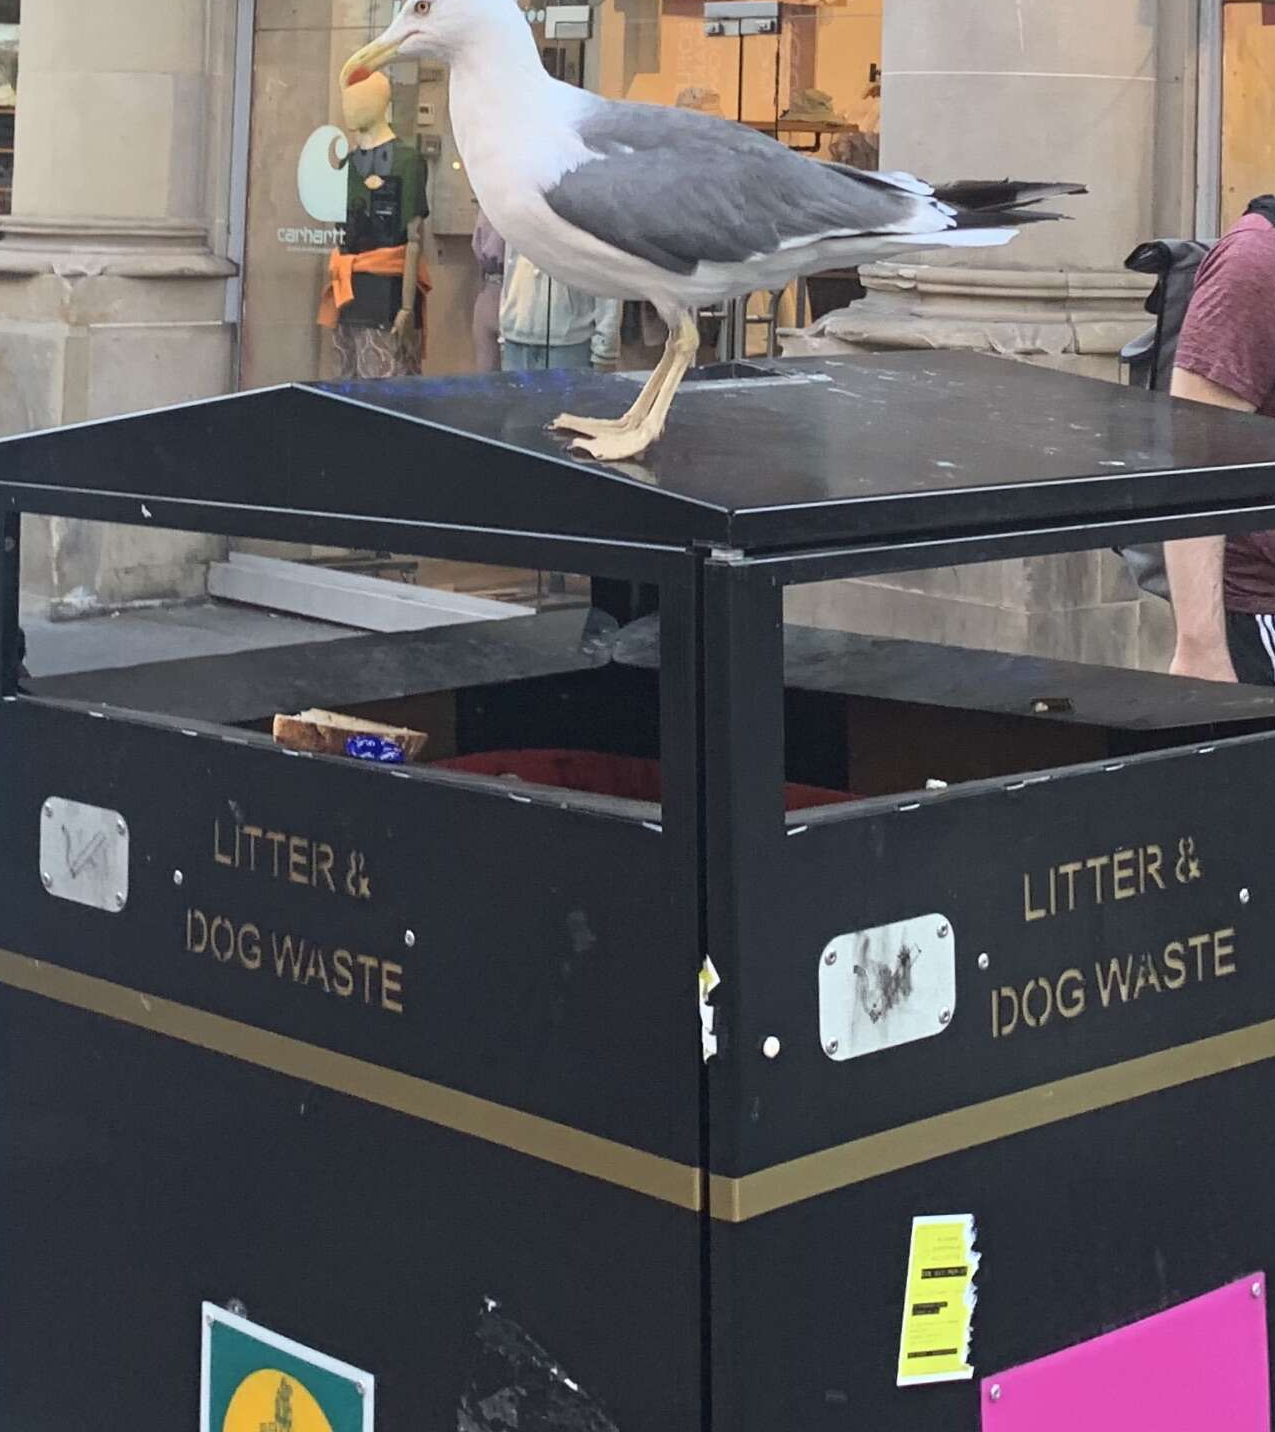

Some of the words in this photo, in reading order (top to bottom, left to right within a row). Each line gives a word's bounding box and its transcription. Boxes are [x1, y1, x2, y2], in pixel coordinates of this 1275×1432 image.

[214, 818, 336, 893] LITTER
[345, 849, 371, 899] &
[1024, 844, 1166, 922] LITTER
[1175, 835, 1202, 884] &
[186, 908, 262, 969] DOG
[272, 932, 404, 1013] WASTE
[991, 968, 1086, 1039] DOG
[1094, 927, 1237, 1008] WASTE
